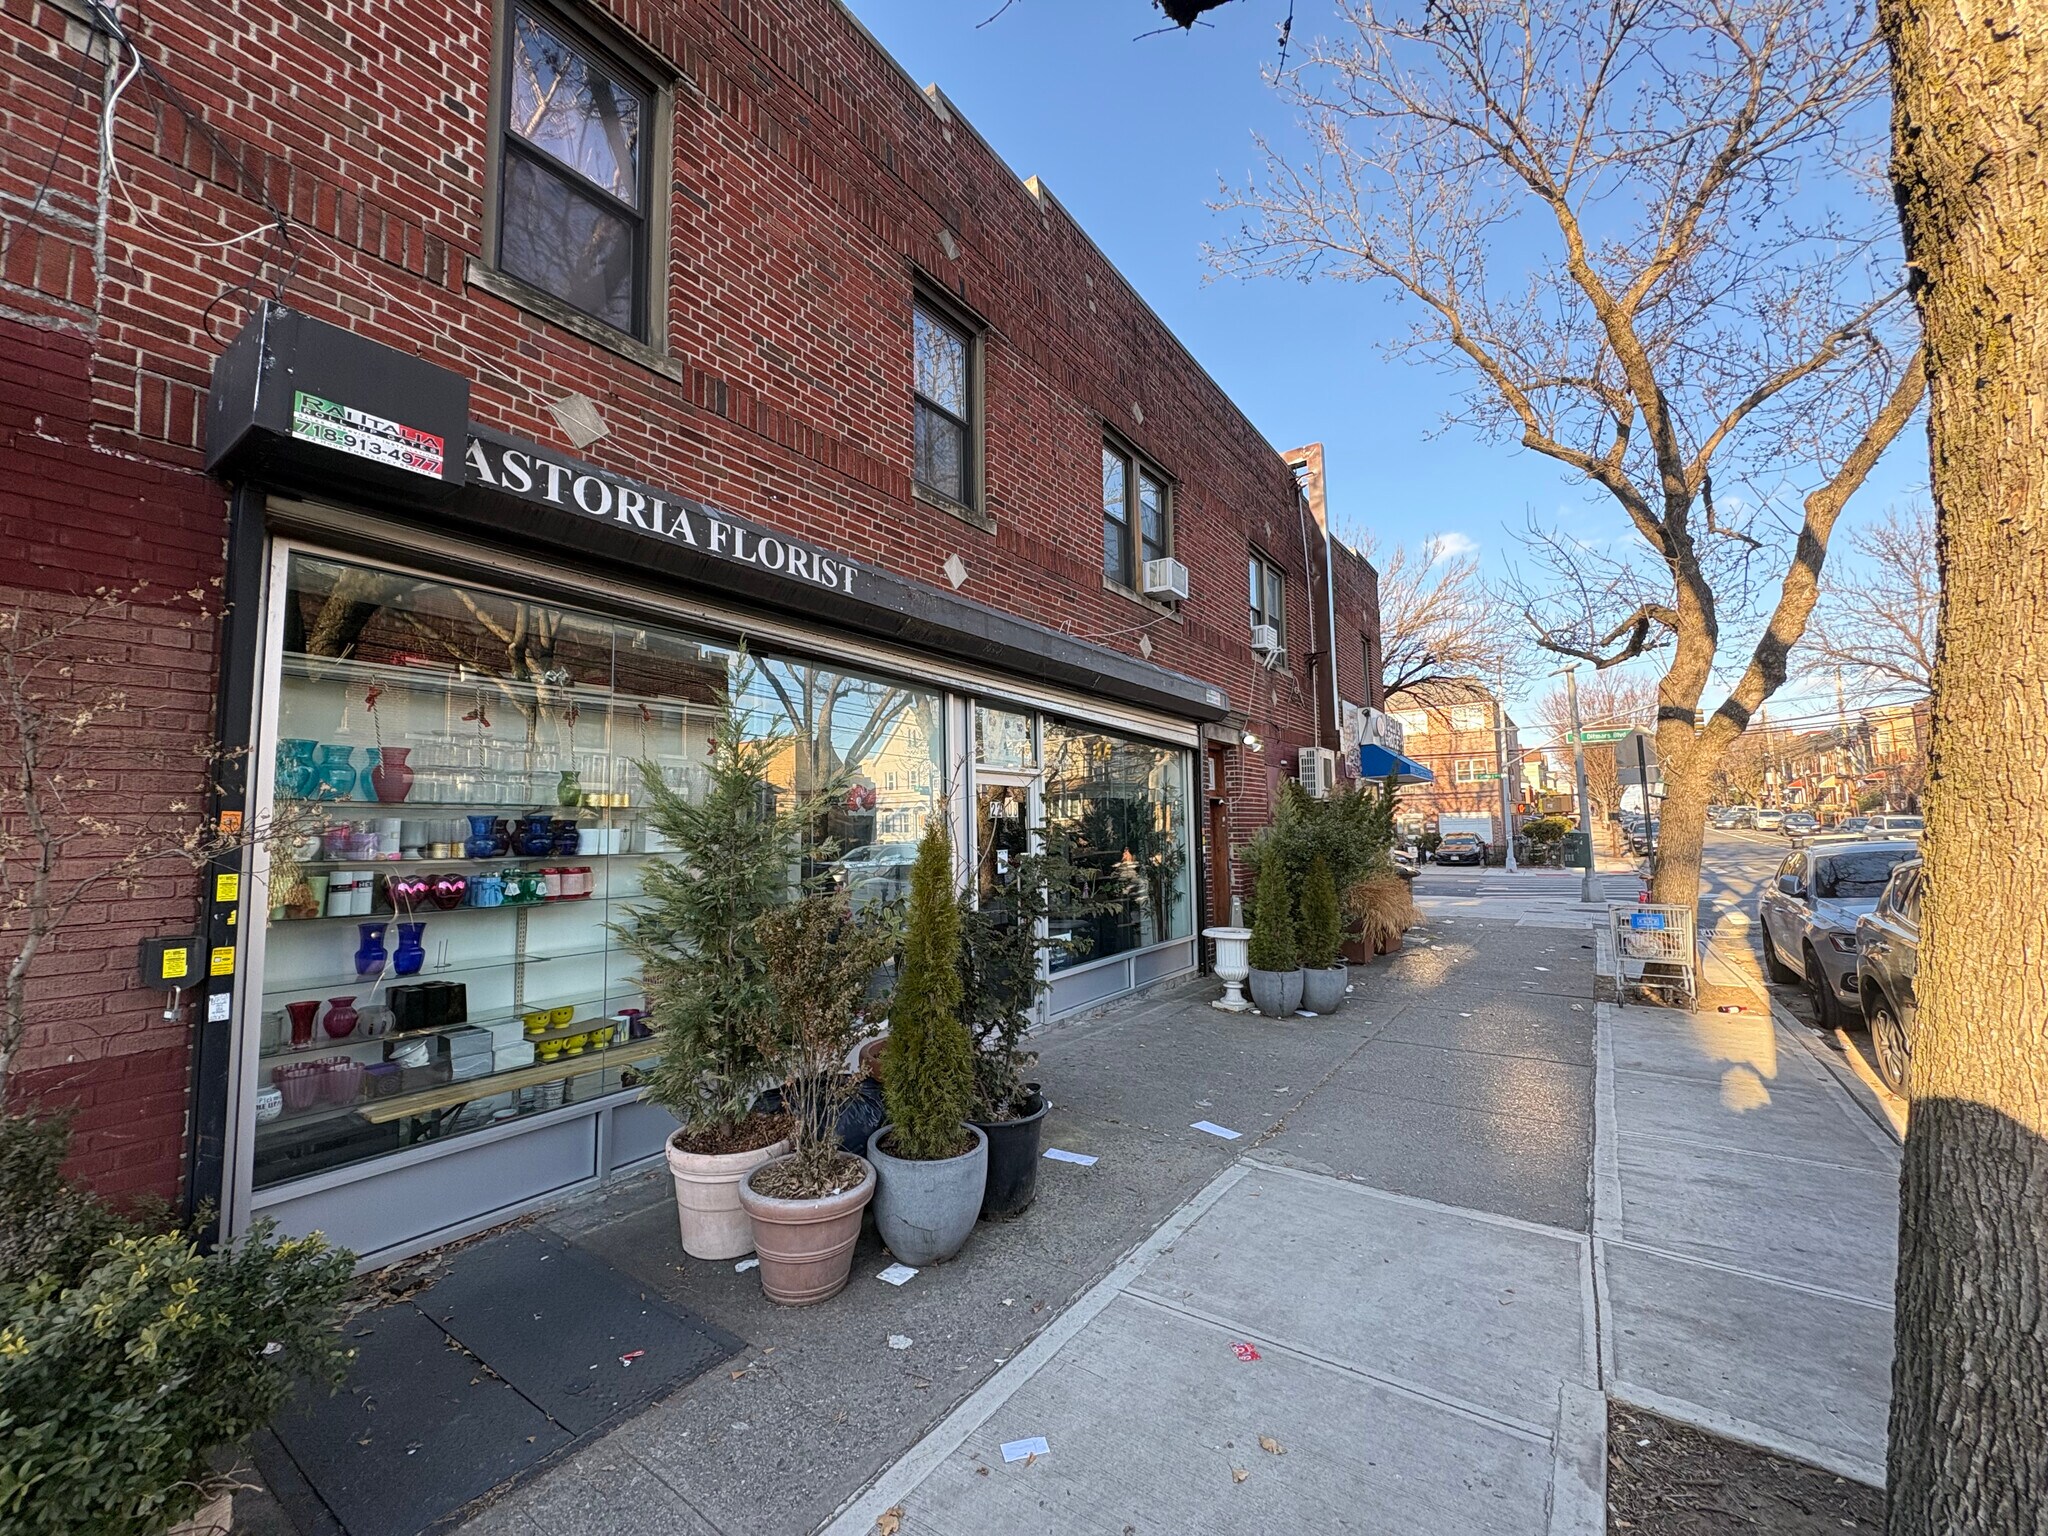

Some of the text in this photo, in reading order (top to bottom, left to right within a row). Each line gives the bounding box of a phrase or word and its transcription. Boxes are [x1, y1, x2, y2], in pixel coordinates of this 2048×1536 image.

[296, 419, 440, 472] 718-913-4977
[301, 395, 439, 448] RAI ITALIA
[302, 407, 438, 454] ROLL UP GATES
[337, 425, 372, 439] SERVICE
[465, 438, 858, 595] ASTORIA FLORIST
